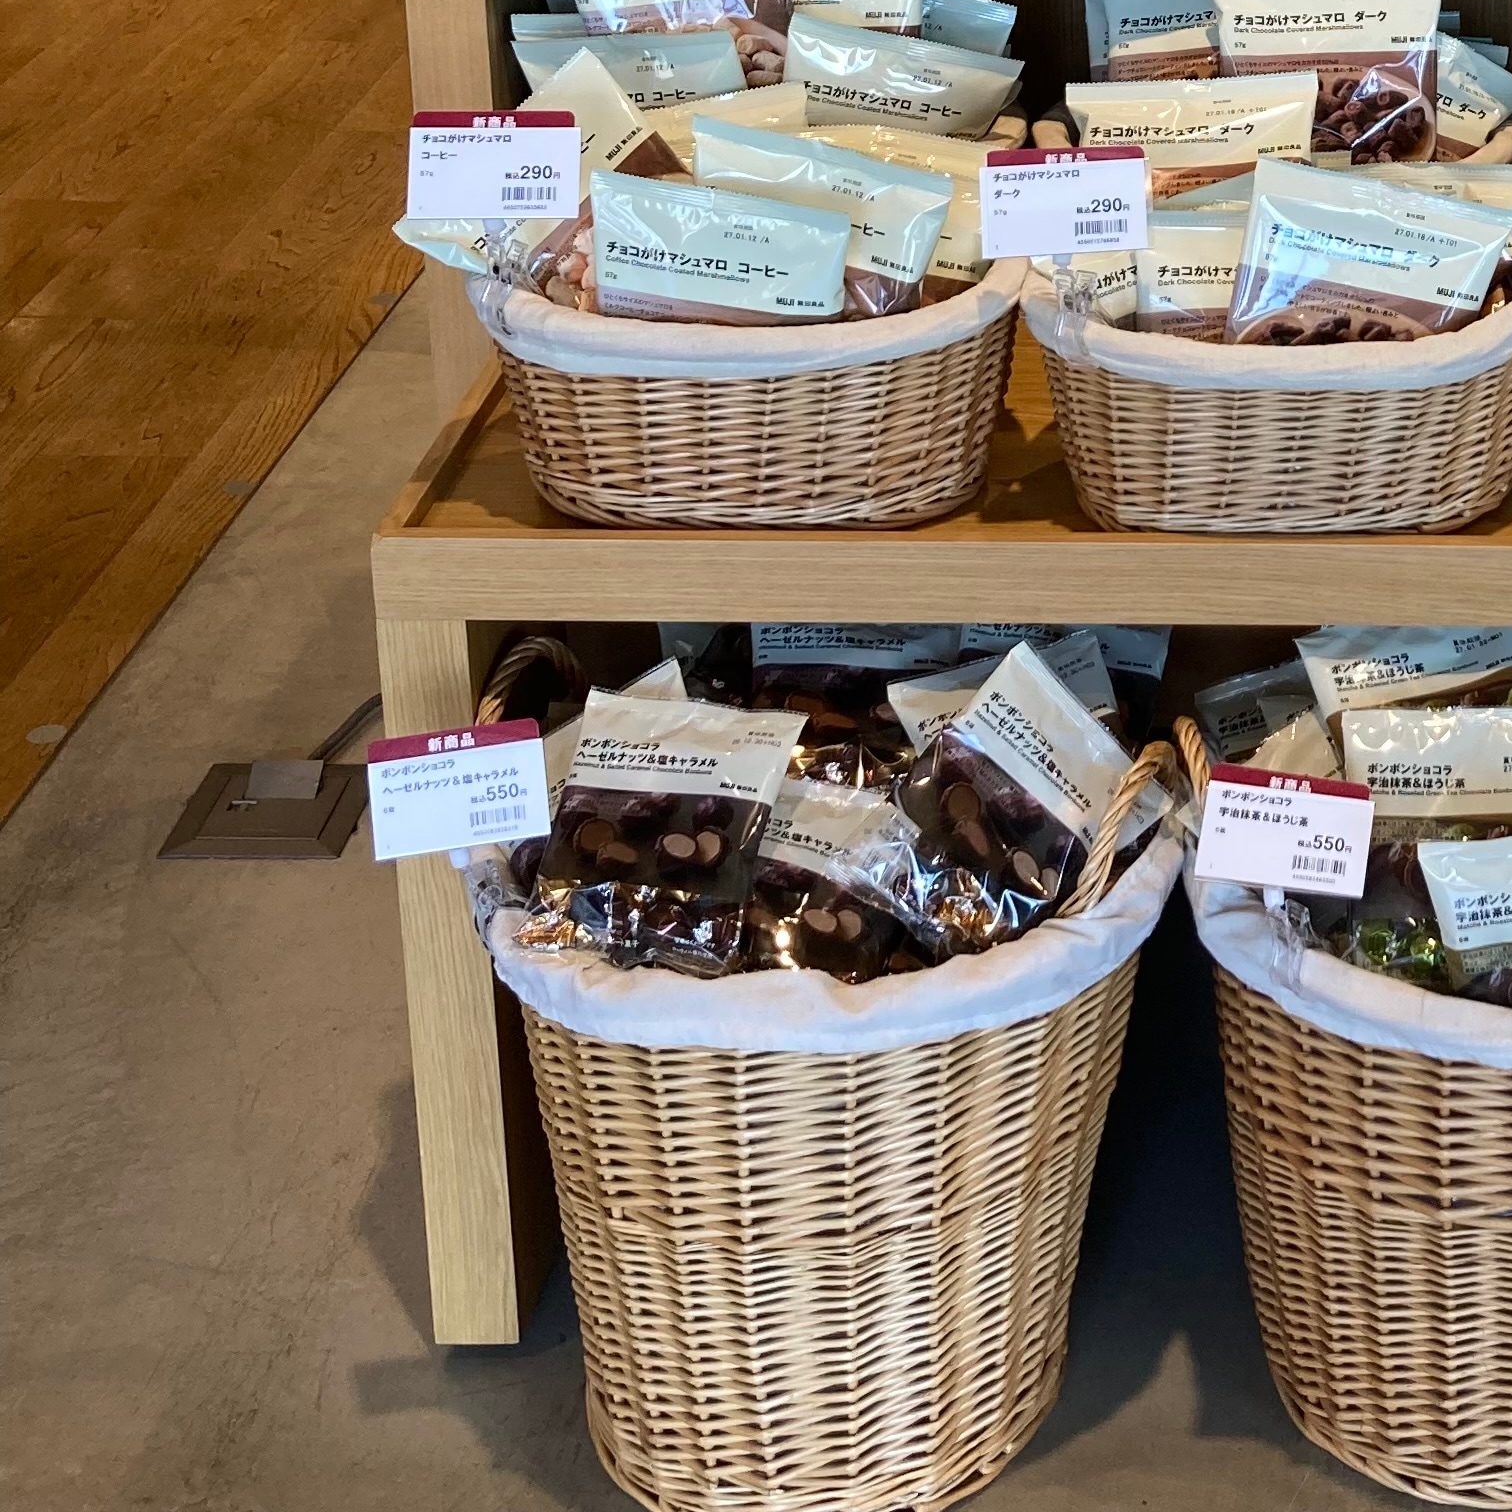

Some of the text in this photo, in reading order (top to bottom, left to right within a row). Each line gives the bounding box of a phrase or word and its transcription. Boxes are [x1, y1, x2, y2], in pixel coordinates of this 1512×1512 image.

[1120, 10, 1217, 28] チョコがけマシュマ
[1234, 10, 1387, 26] チョコがけマシュマロ ダーク
[652, 90, 696, 101] コーヒー
[804, 81, 962, 117] チョコがけマシュマロ コーヒー
[1459, 101, 1487, 120] ダーク
[472, 116, 517, 128] 新商品
[1089, 123, 1255, 138] チョコがけマシュマロ ダーク
[422, 134, 512, 144] チョコがけマシュマロ
[421, 151, 458, 160] コーヒー
[606, 146, 623, 161] MUJI
[1045, 153, 1088, 163] 新商品
[505, 166, 561, 180] 税込290円
[992, 168, 1080, 182] チョコがけマシュマロ
[993, 189, 1020, 198] ダーク
[1076, 198, 1130, 214] 税込290円
[1271, 222, 1393, 258] チョコがけマシュマロ
[606, 241, 788, 279] チョコがけマシュマロ コーヒー
[871, 255, 888, 267] MUJI
[936, 259, 955, 270] MUJI
[1158, 264, 1236, 278] チョコがけマ
[1436, 286, 1455, 298] MUJI
[776, 296, 795, 306] MUJI
[427, 732, 475, 752] 新商品
[1269, 776, 1312, 793] 新商品
[1367, 776, 1466, 789] 宇治抹茶&ほうじ茶
[470, 783, 527, 803] 税込550円
[1298, 835, 1352, 853] 税込550円
